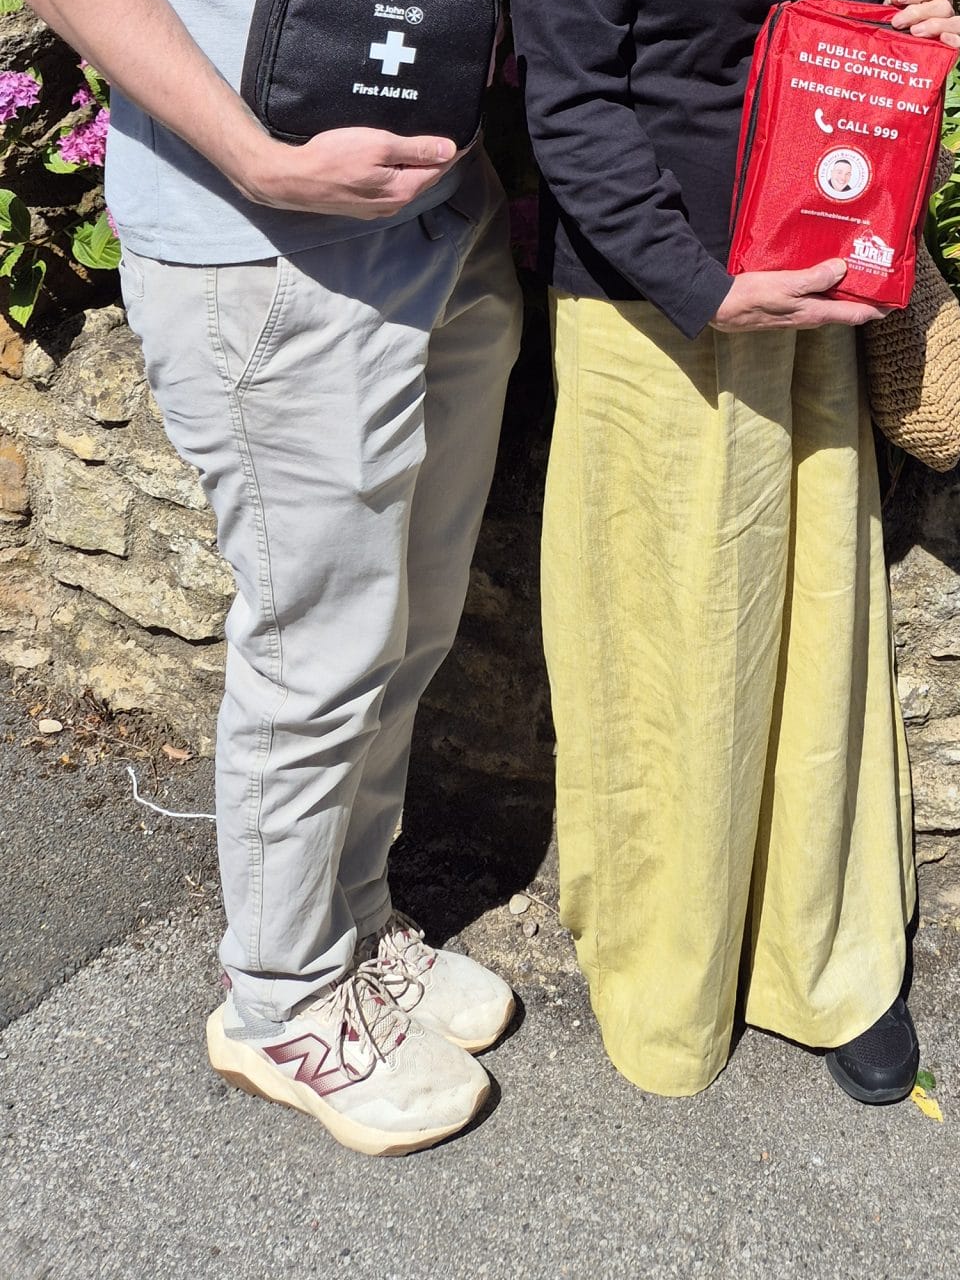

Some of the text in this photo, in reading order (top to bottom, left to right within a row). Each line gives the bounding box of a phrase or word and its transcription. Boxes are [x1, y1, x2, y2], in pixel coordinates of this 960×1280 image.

[375, 3, 405, 15] St John
[800, 52, 933, 89] BLEED CONTROL KIT
[818, 42, 919, 73] PUBLIC ACCESS
[352, 83, 419, 100] First Aid Kit
[790, 78, 931, 116] EMERGENCY USE ONLY
[837, 119, 899, 140] CALL 999
